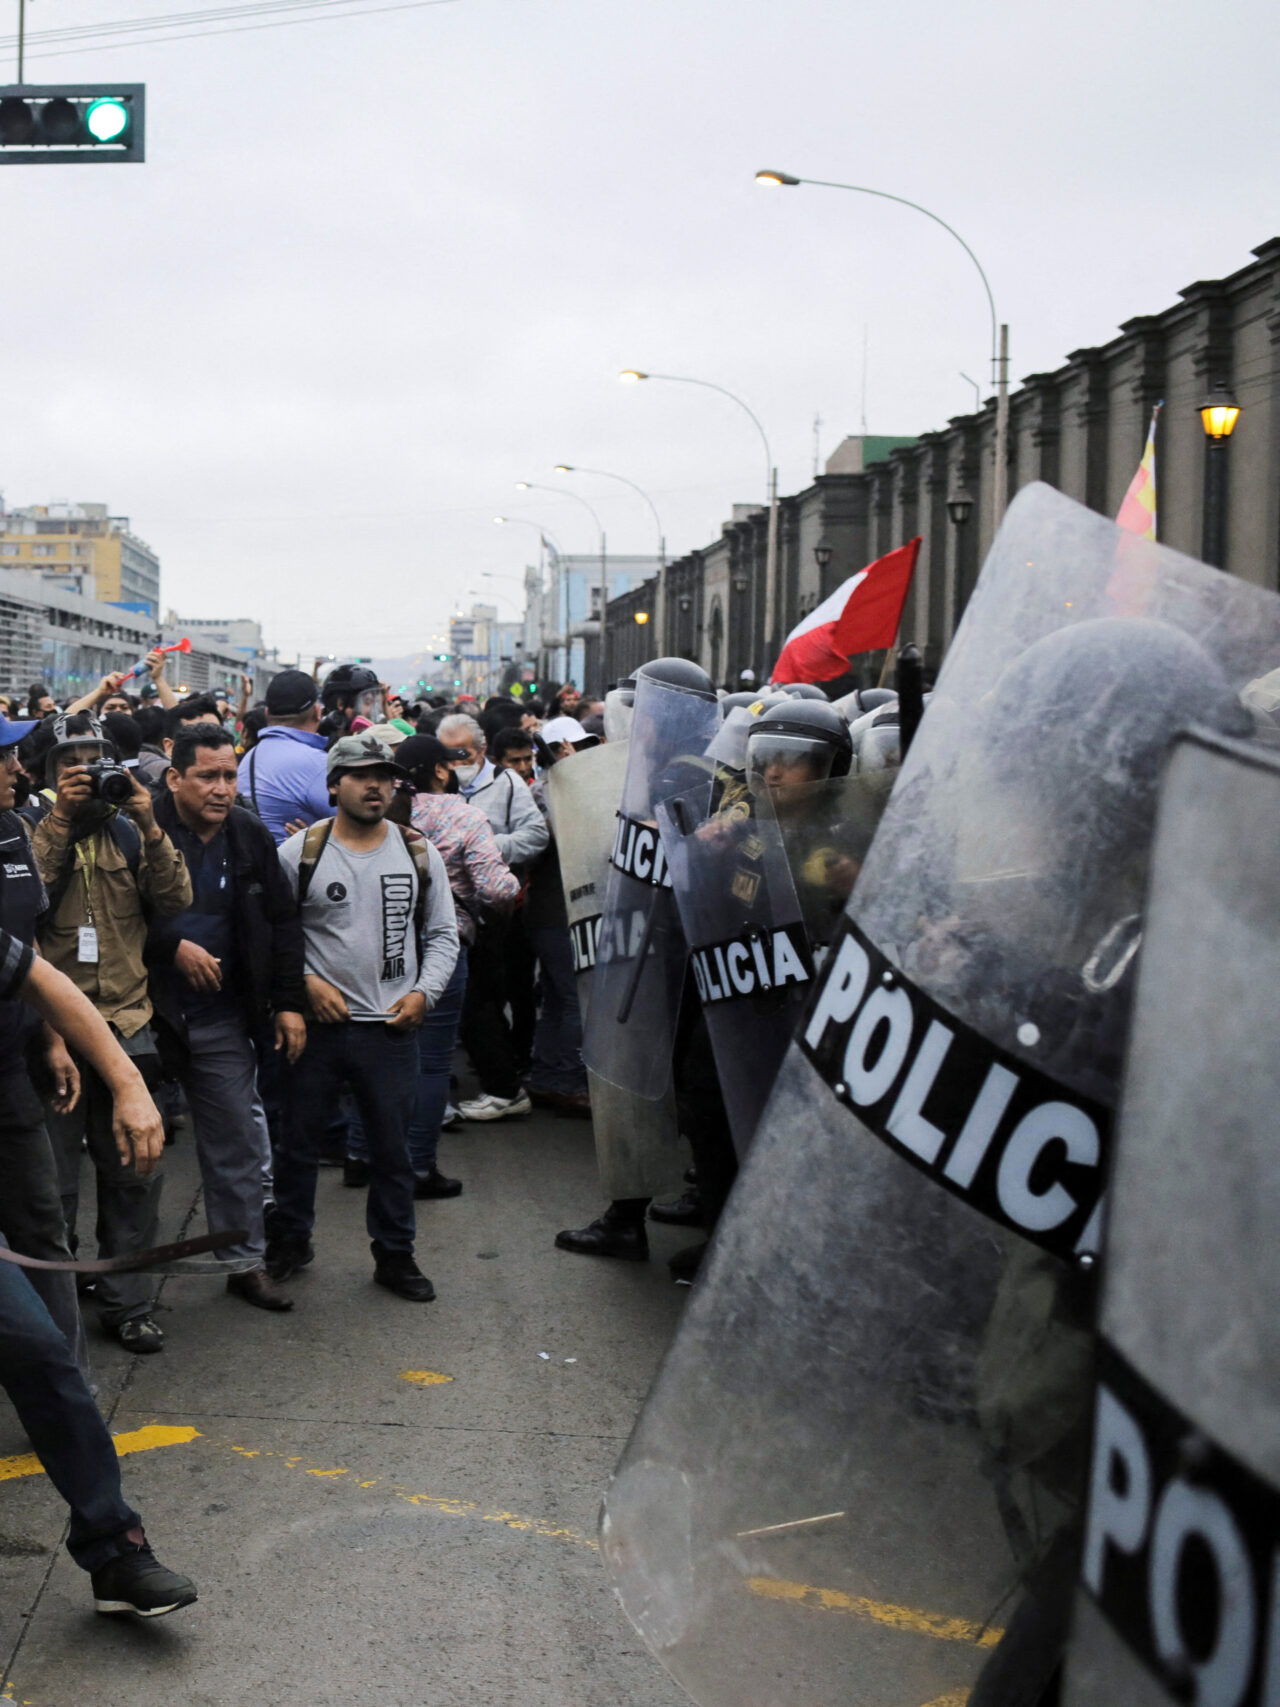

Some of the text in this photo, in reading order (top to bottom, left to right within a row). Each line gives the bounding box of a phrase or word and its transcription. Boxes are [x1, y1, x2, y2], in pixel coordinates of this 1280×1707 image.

[381, 874, 412, 959] JORDAN
[380, 957, 406, 981] AIR
[1083, 1380, 1280, 1707] PO
